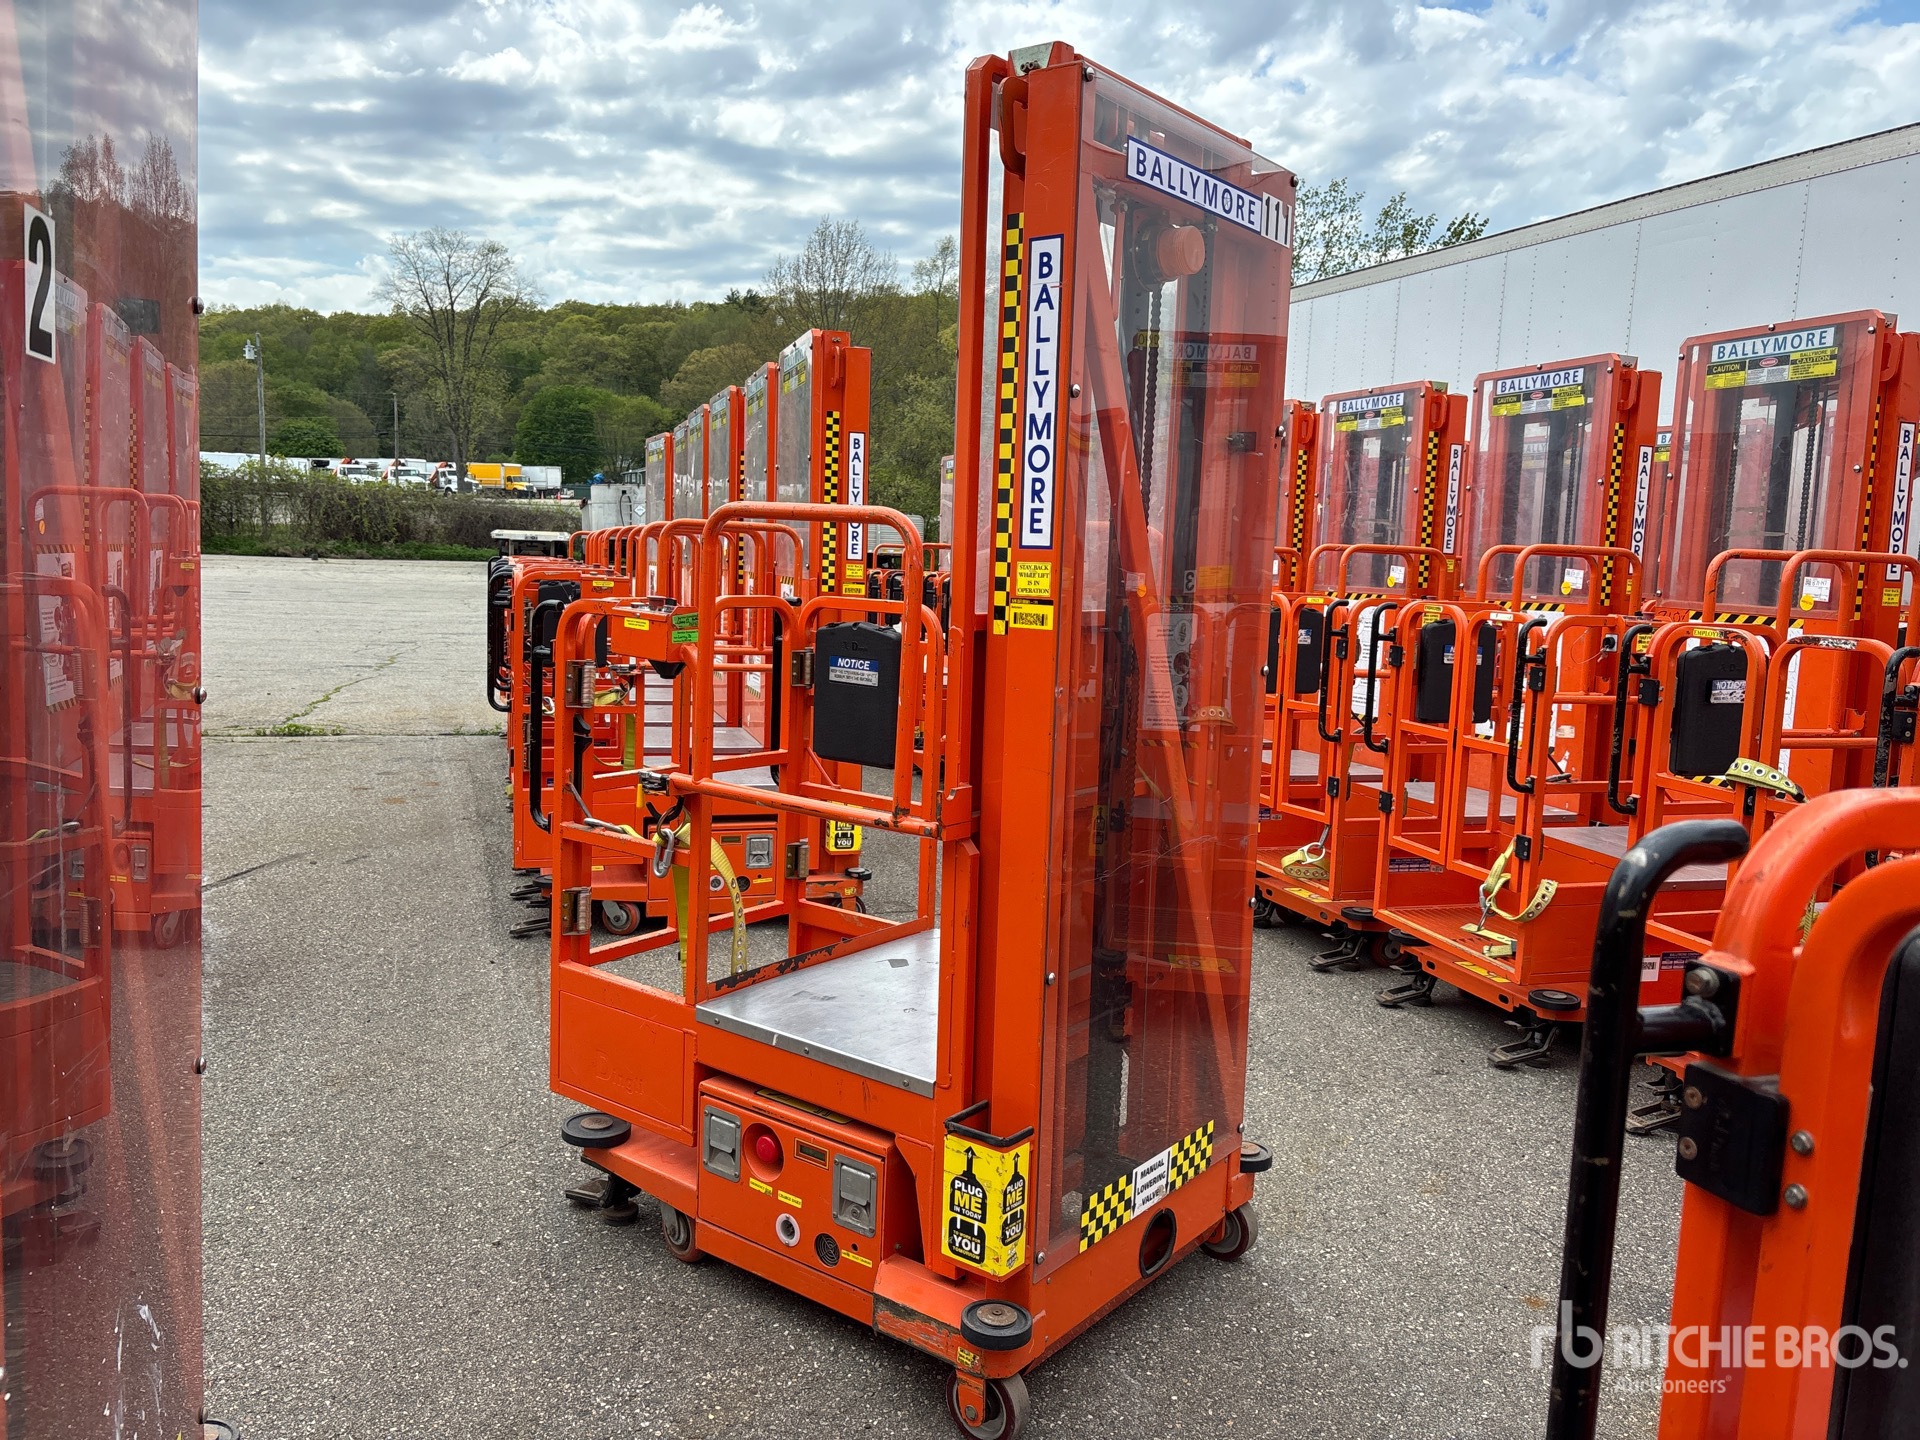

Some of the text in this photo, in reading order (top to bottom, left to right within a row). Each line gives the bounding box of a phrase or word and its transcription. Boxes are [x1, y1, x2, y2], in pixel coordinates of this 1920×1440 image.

[1136, 147, 1256, 226] BALLYMORE
[28, 215, 52, 358] 2
[1716, 330, 1828, 360] BALLYMORE
[1712, 363, 1741, 373] CAUTION
[1796, 355, 1831, 365] CAUTION
[1501, 370, 1579, 393] BALLYMORE
[1028, 251, 1055, 534] BALLYMORE
[1497, 396, 1517, 404] CAUTION
[1342, 394, 1400, 412] BALLYMORE
[850, 438, 861, 555] BALLYORE
[1446, 449, 1459, 549] BALLYMORE
[1633, 451, 1649, 556] BALLYMOR
[838, 658, 871, 670] NOTICE
[1140, 1158, 1165, 1179] MANUAL
[954, 1180, 983, 1198] PLUG
[1006, 1179, 1024, 1194] PLUG
[1137, 1171, 1166, 1195] LOWERING
[954, 1190, 982, 1214] ME
[1006, 1187, 1023, 1206] ME
[962, 1208, 982, 1220] TODAY
[1005, 1222, 1022, 1239] YOU
[953, 1235, 981, 1255] YOU
